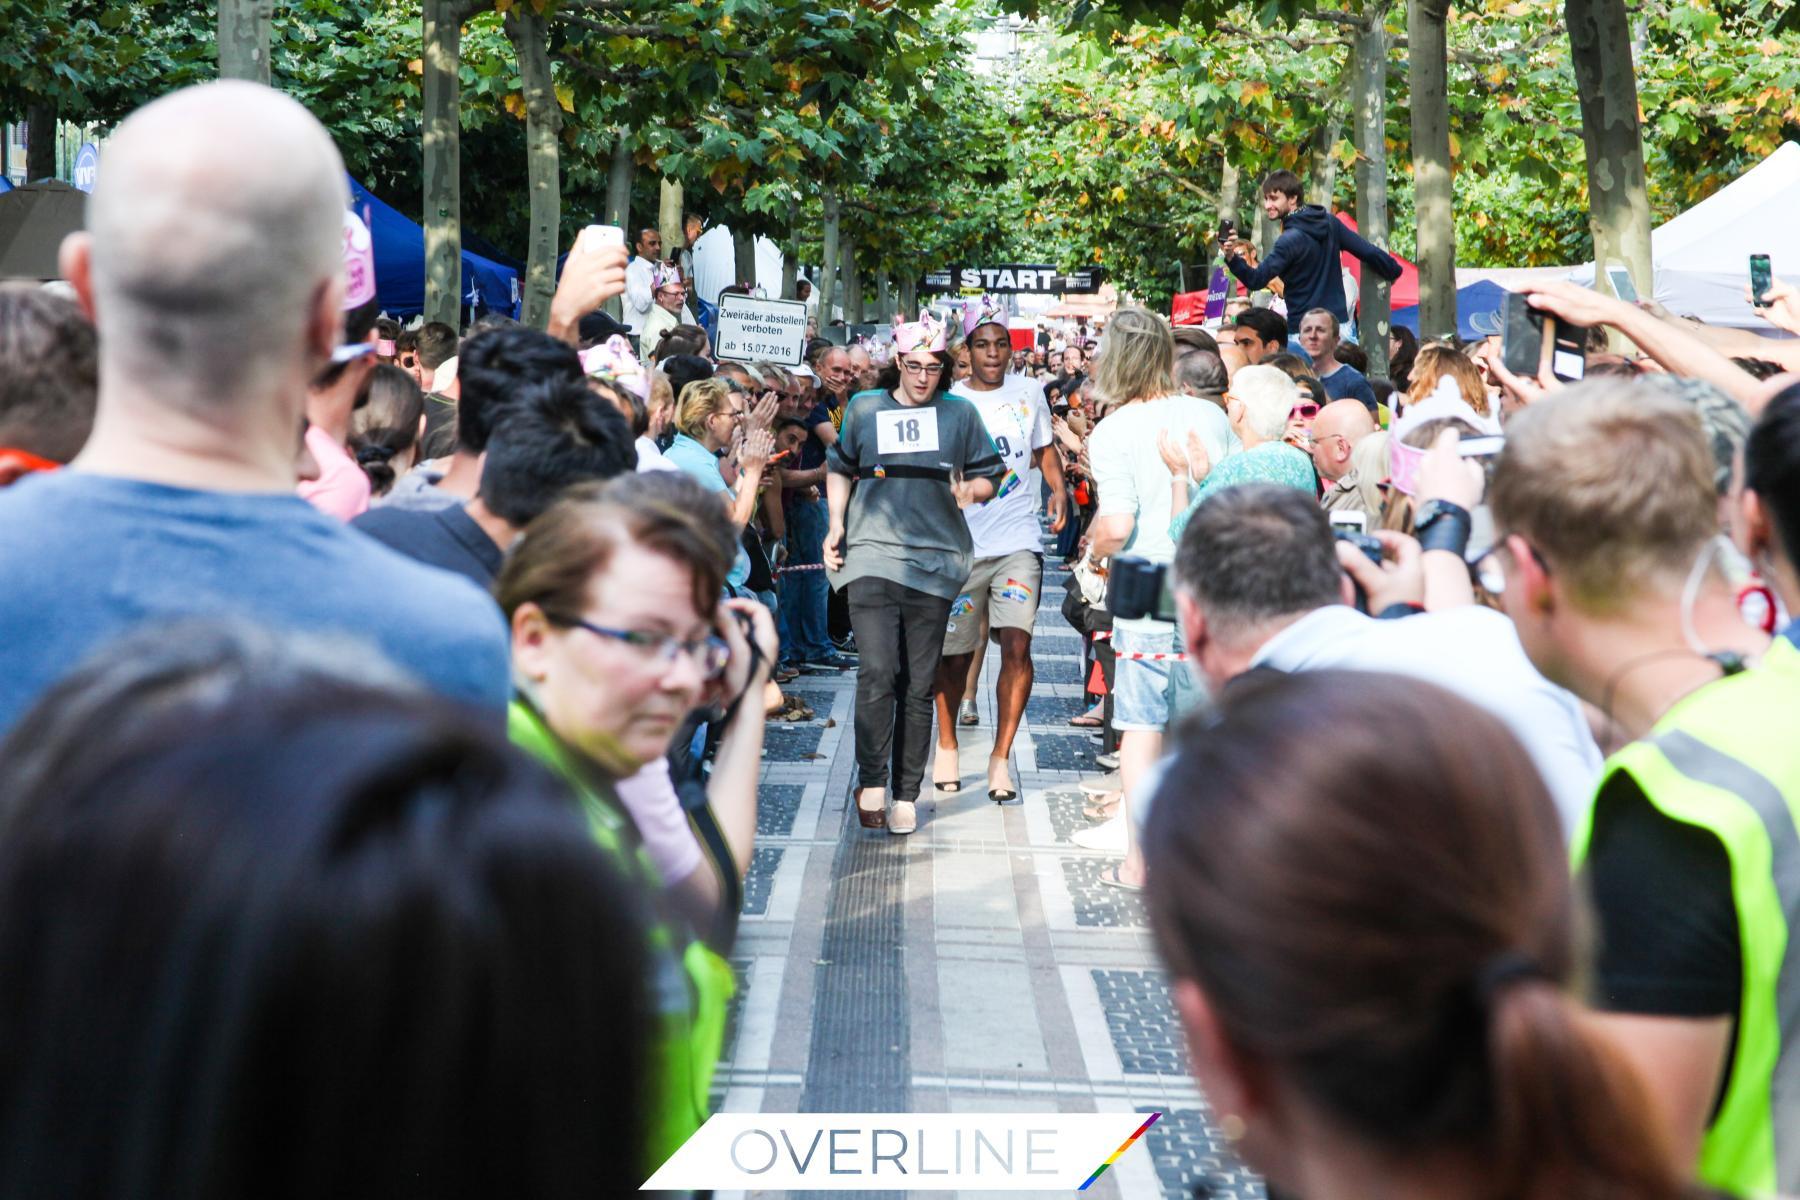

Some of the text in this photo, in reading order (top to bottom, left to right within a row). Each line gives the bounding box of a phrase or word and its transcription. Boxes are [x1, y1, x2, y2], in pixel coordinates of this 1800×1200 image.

[960, 268, 1057, 290] START
[720, 309, 804, 326] Zweiräder abstellen
[741, 324, 783, 335] verboten
[724, 341, 791, 356] ab 15.07.2016
[894, 418, 920, 443] 18
